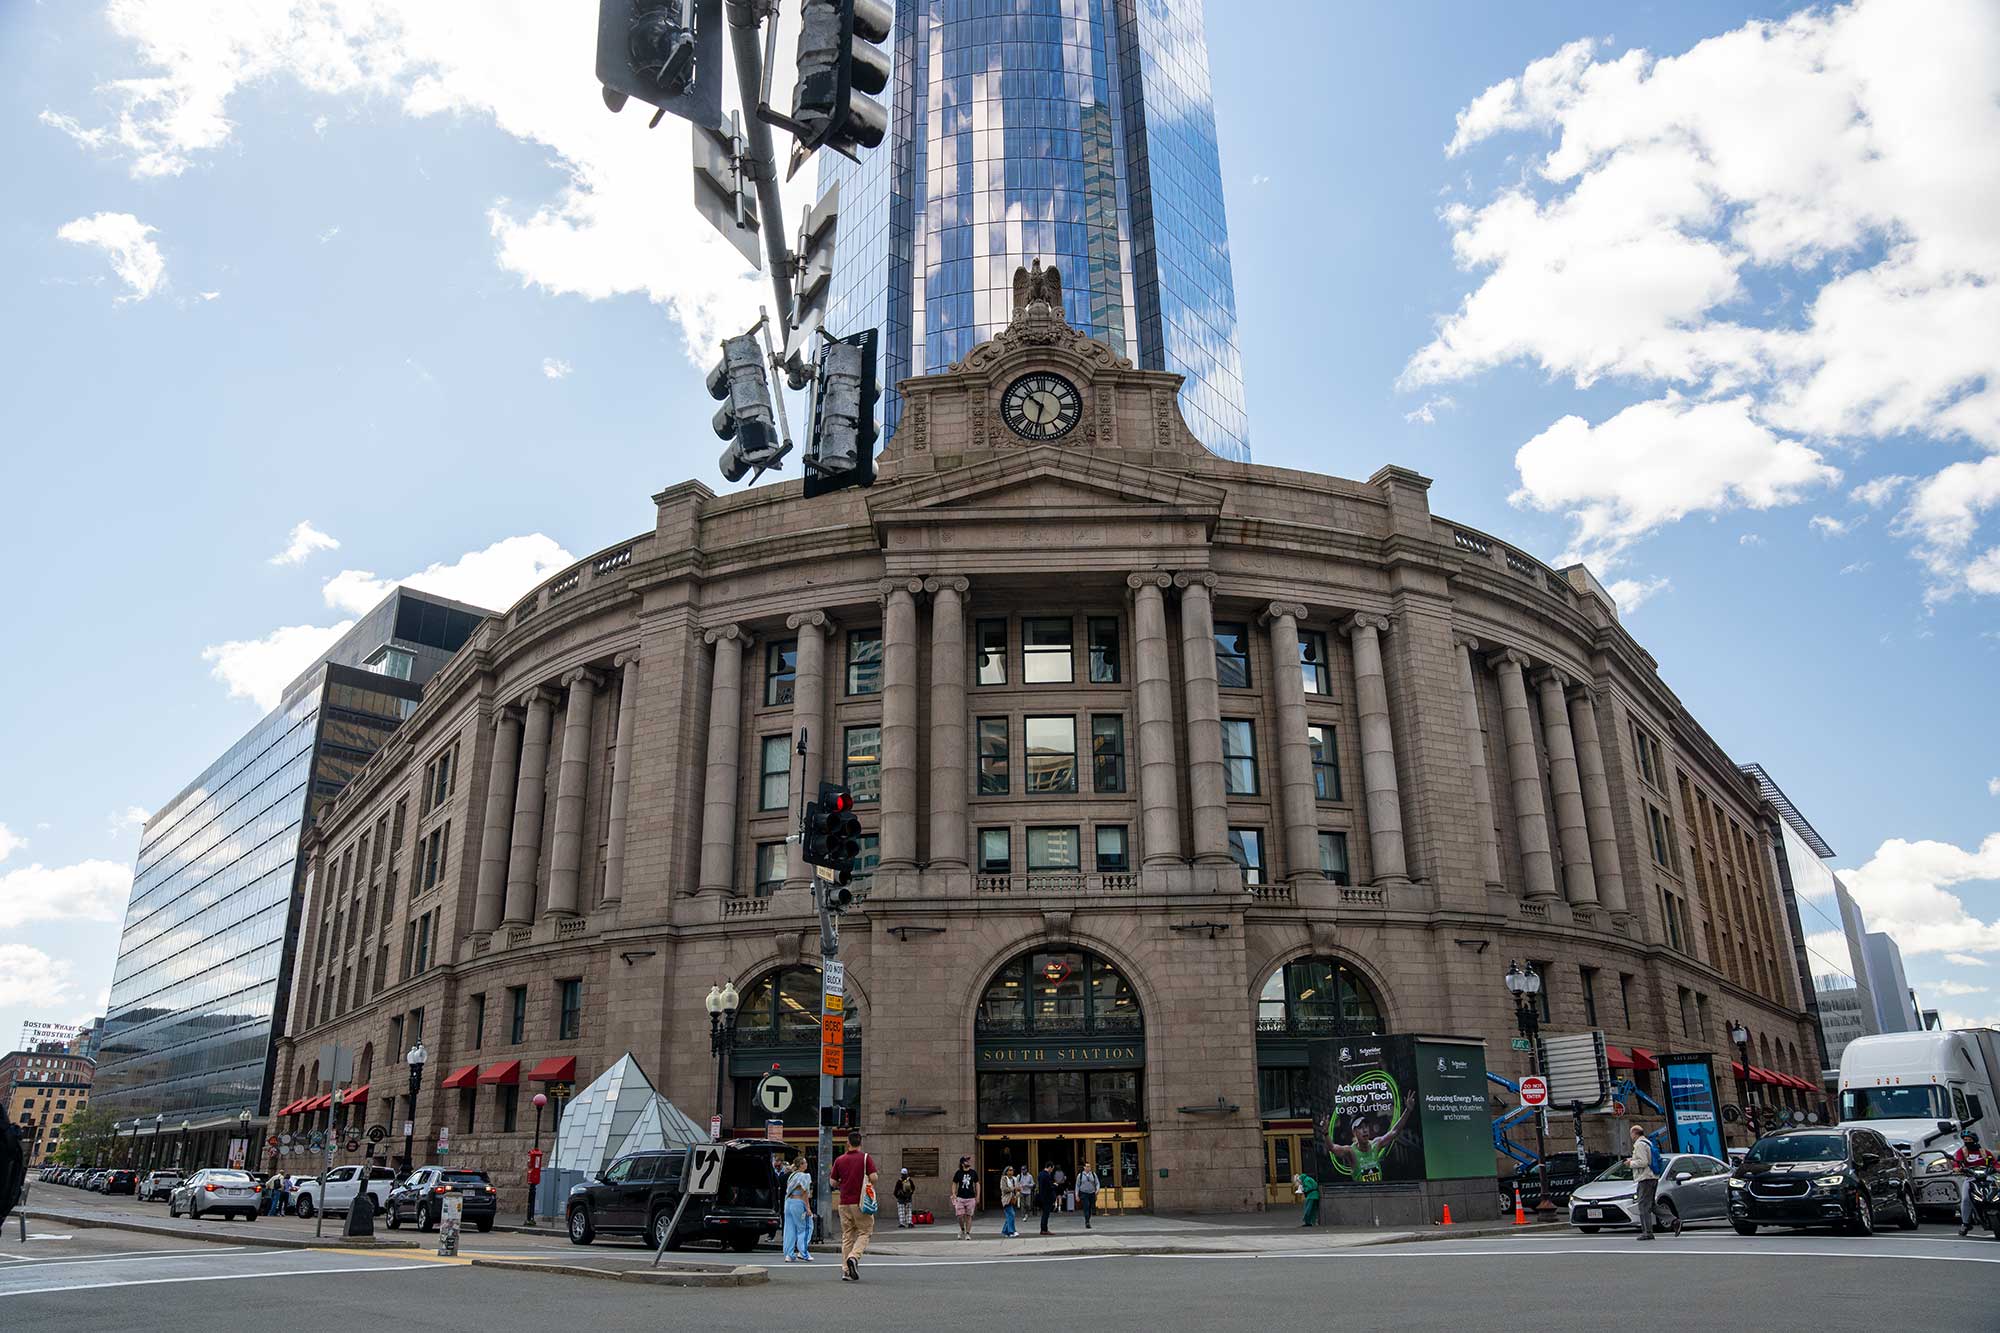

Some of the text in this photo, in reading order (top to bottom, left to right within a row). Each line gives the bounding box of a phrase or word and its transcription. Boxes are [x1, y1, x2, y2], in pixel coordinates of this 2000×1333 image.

[23, 1020, 51, 1029] BOSTON
[33, 1030, 74, 1039] INDUSTRIAL
[984, 1048, 1135, 1061] SOUTH STATION
[1337, 1081, 1388, 1093] Advancing
[765, 1085, 788, 1108] T
[1334, 1091, 1393, 1104] Energy Tech
[1425, 1094, 1453, 1103] Advancing
[1453, 1094, 1472, 1103] Energy
[1335, 1102, 1392, 1115] to go further
[1550, 1179, 1574, 1187] POLICE
